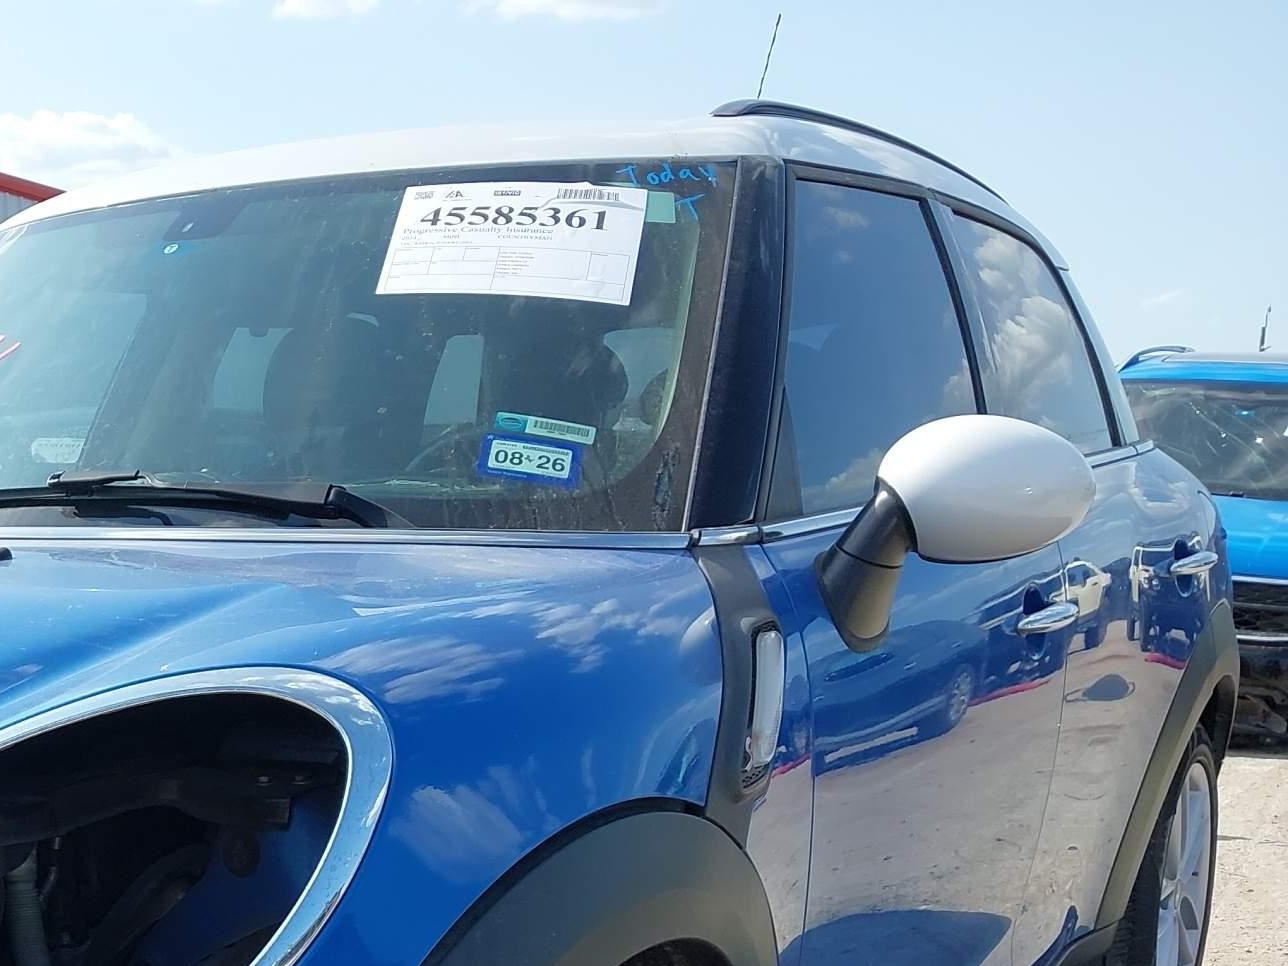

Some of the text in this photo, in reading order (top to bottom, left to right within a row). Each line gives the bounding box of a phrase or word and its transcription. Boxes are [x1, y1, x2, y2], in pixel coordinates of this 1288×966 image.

[616, 161, 718, 187] Today
[403, 225, 554, 236] Progressive Casualty Insurance
[420, 205, 609, 232] 45585361
[494, 449, 567, 473] 08 26
